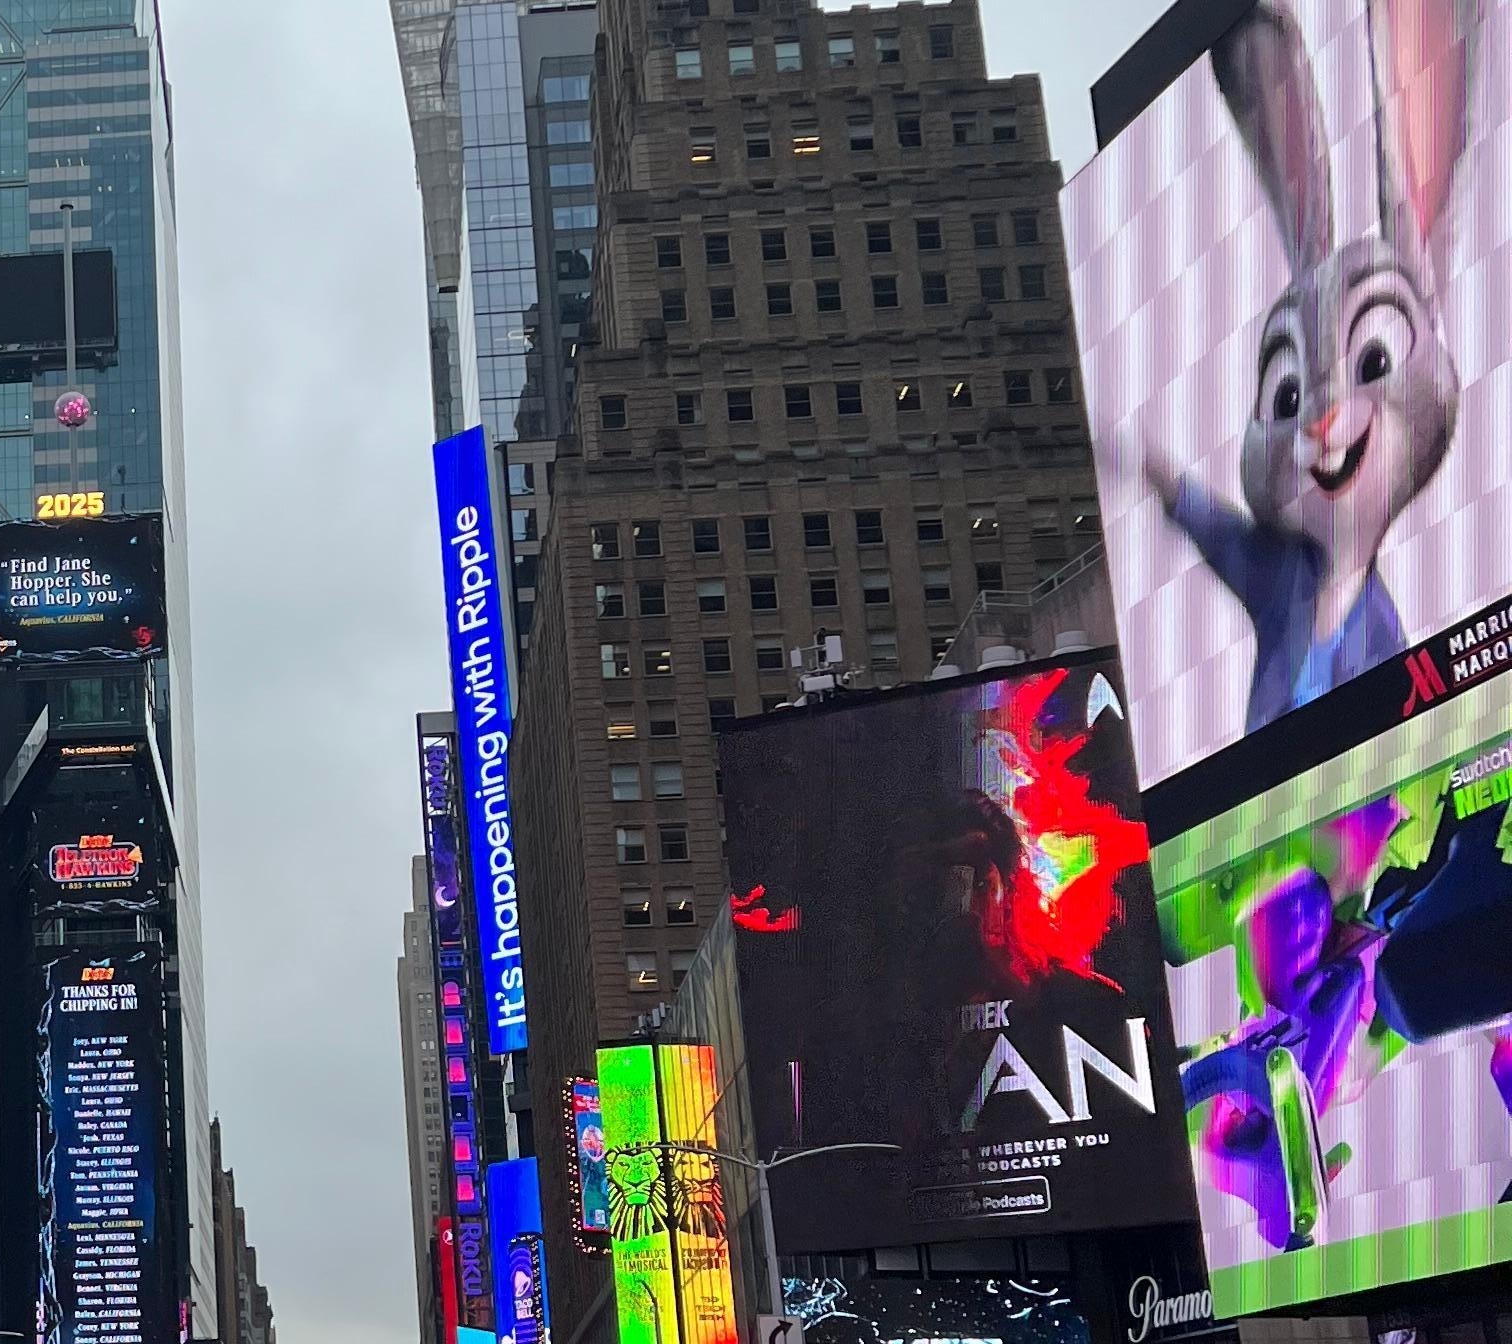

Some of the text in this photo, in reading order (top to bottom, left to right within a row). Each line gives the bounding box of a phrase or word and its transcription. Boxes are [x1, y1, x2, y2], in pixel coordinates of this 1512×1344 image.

[37, 492, 105, 518] 2025
[53, 556, 90, 573] Jane
[10, 570, 112, 592] Hopper. She
[10, 594, 39, 608] can
[45, 588, 82, 607] help
[451, 504, 527, 1029] It's happening with Ripple
[55, 861, 136, 879] HAWKINS
[61, 983, 136, 999] THANKS FOR
[59, 998, 118, 1012] CHIPPING
[1074, 1133, 1111, 1149] YOU
[982, 1192, 1045, 1211] Podcasts
[1128, 1276, 1214, 1343] Paramo
